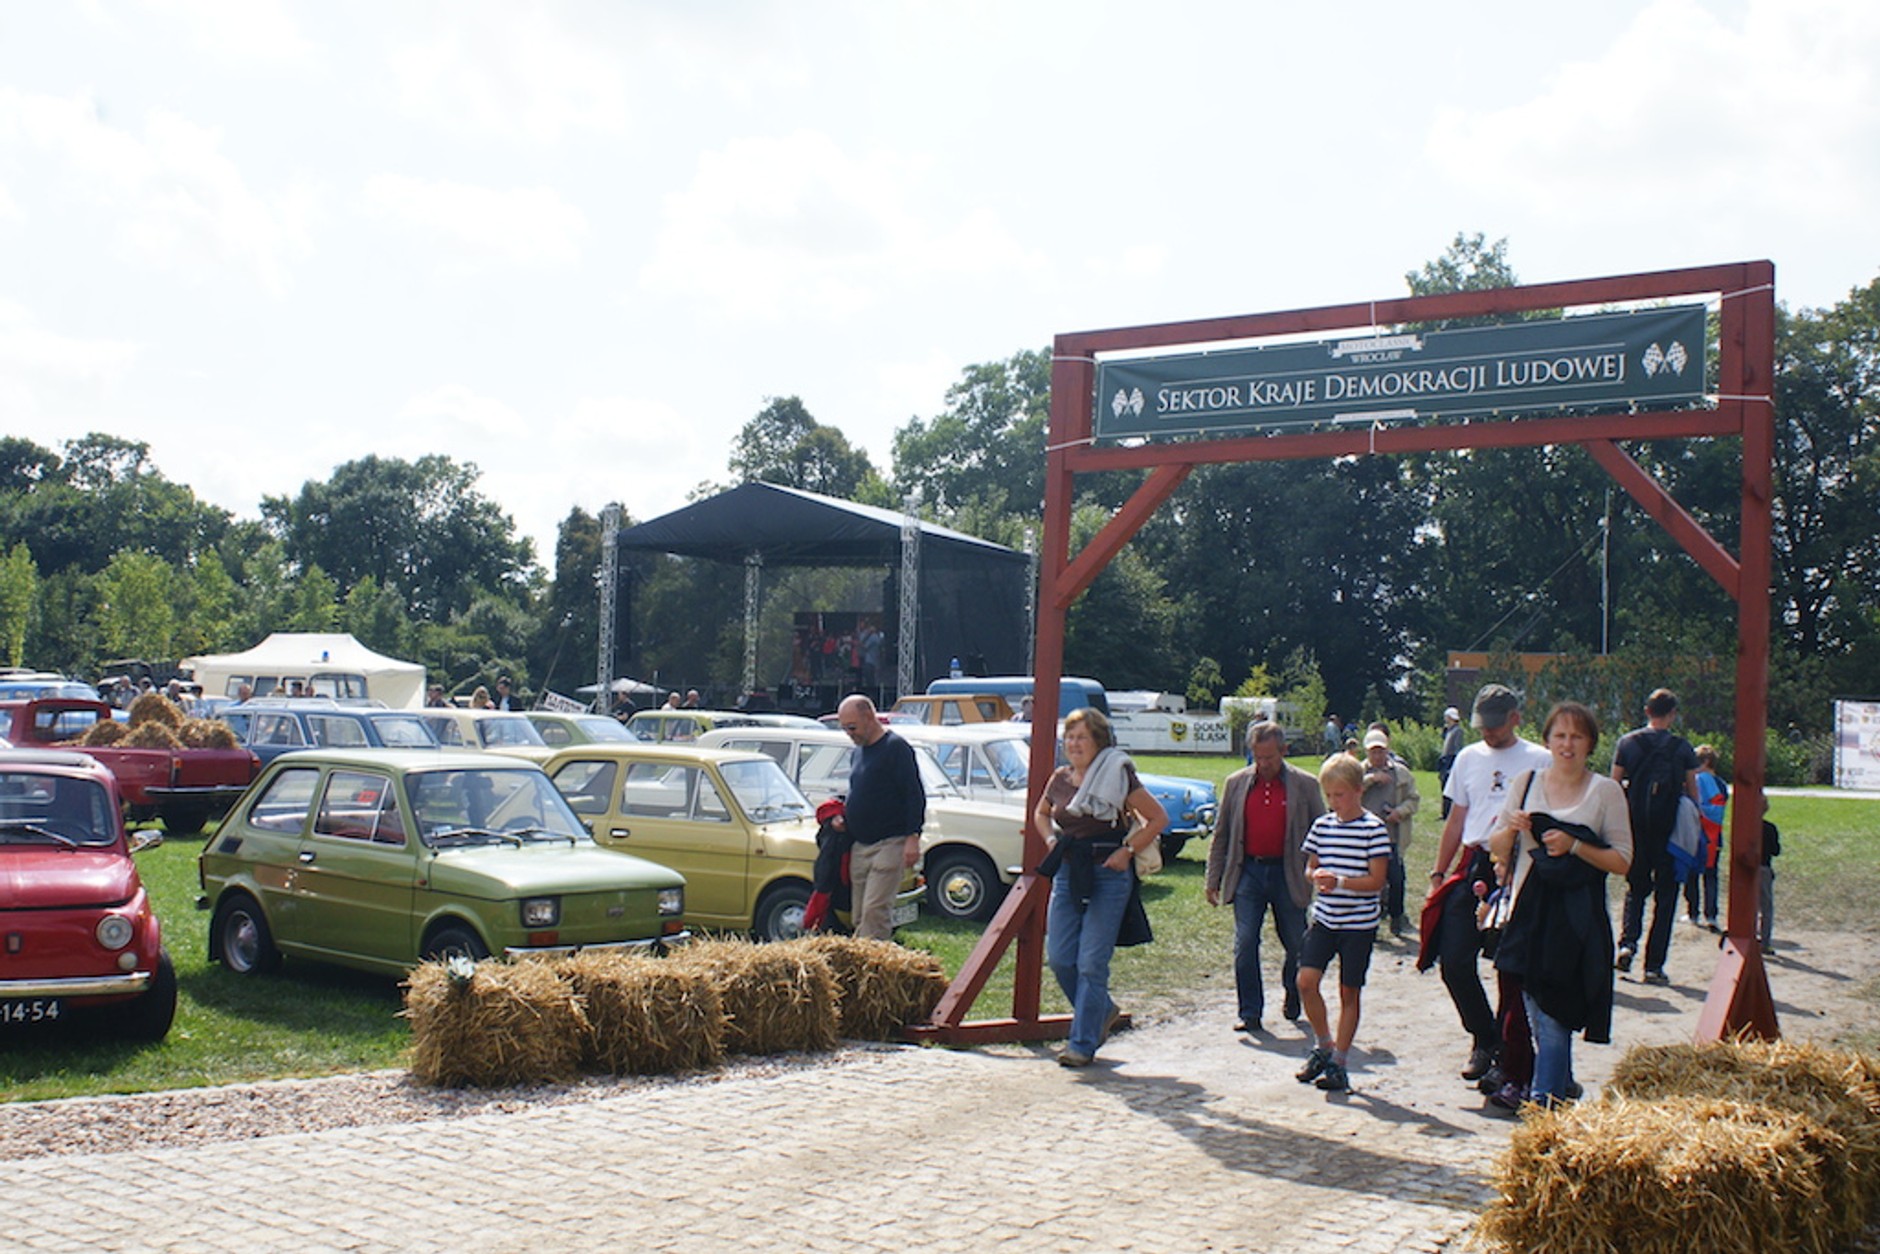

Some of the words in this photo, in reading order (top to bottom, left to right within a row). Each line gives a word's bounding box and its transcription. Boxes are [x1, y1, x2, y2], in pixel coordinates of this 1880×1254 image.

[1156, 386, 1241, 413] SEKTOR
[1249, 379, 1315, 407] KRAJE
[1324, 365, 1487, 400] DEMOKRACJI
[1496, 353, 1627, 386] LUDOWEJ
